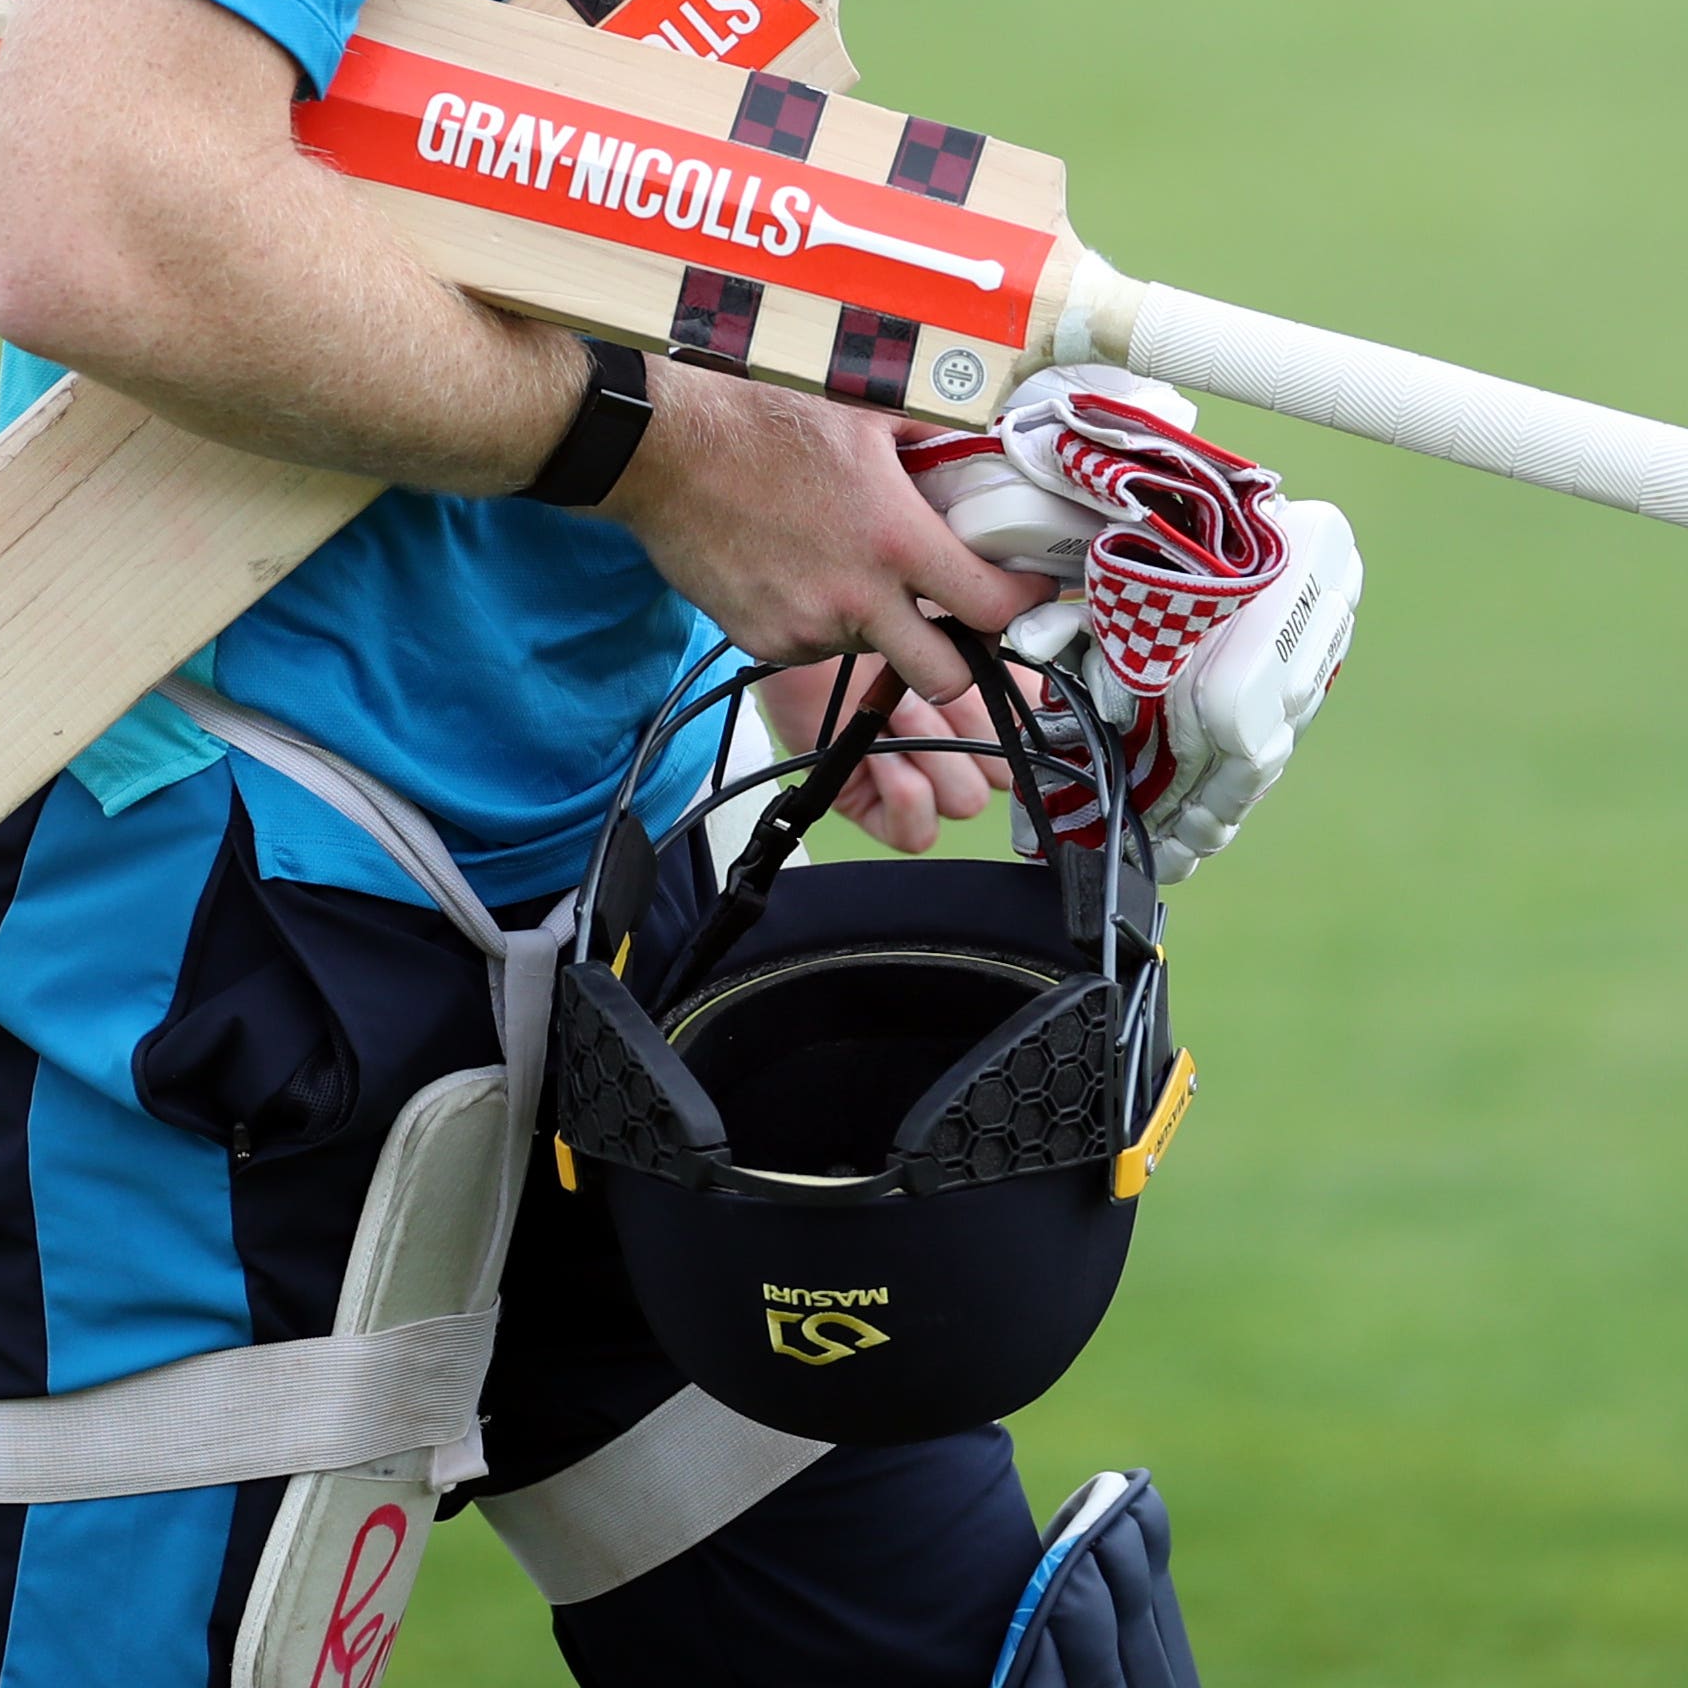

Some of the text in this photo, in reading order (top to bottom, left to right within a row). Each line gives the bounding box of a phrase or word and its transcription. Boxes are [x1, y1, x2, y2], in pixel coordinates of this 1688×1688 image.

[416, 91, 811, 257] GRAY-NICOLLS
[1275, 572, 1321, 664] ORIGINAL
[762, 1282, 889, 1307] MASURI
